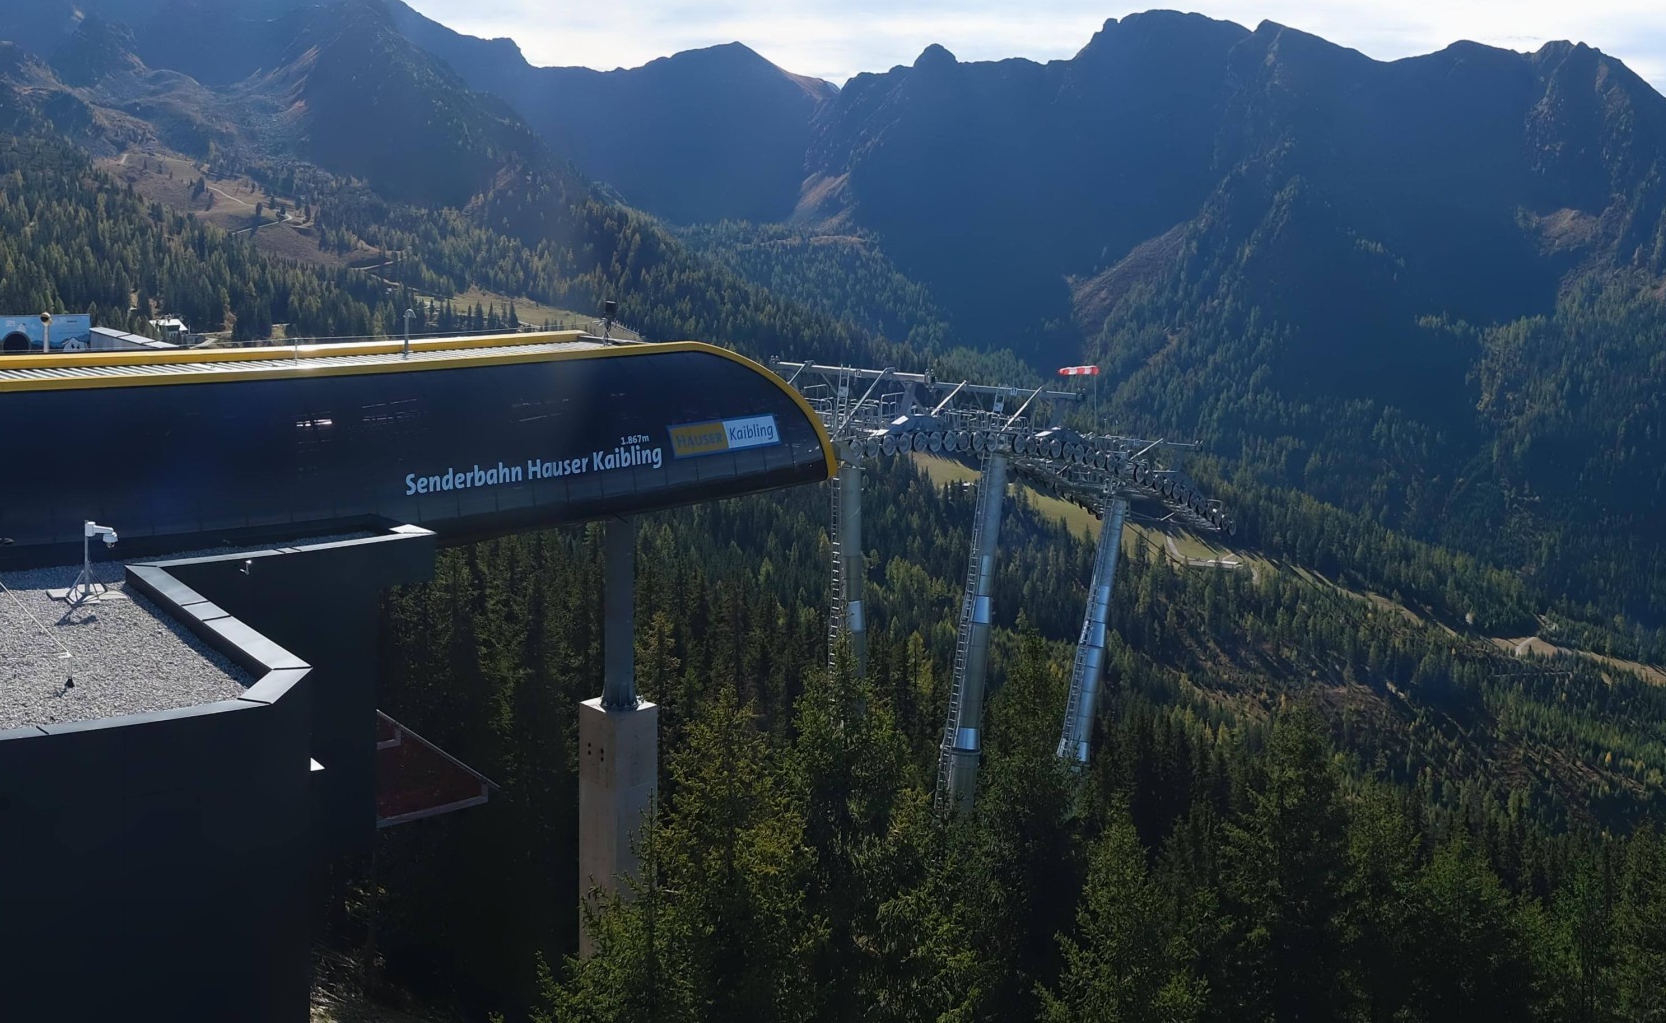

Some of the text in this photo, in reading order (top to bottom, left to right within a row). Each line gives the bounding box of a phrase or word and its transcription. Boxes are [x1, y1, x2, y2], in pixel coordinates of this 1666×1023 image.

[620, 434, 650, 445] 1.867m
[676, 423, 774, 448] HAUSER Kaibling
[405, 444, 663, 496] Senderbahn Hauser Kaibling
